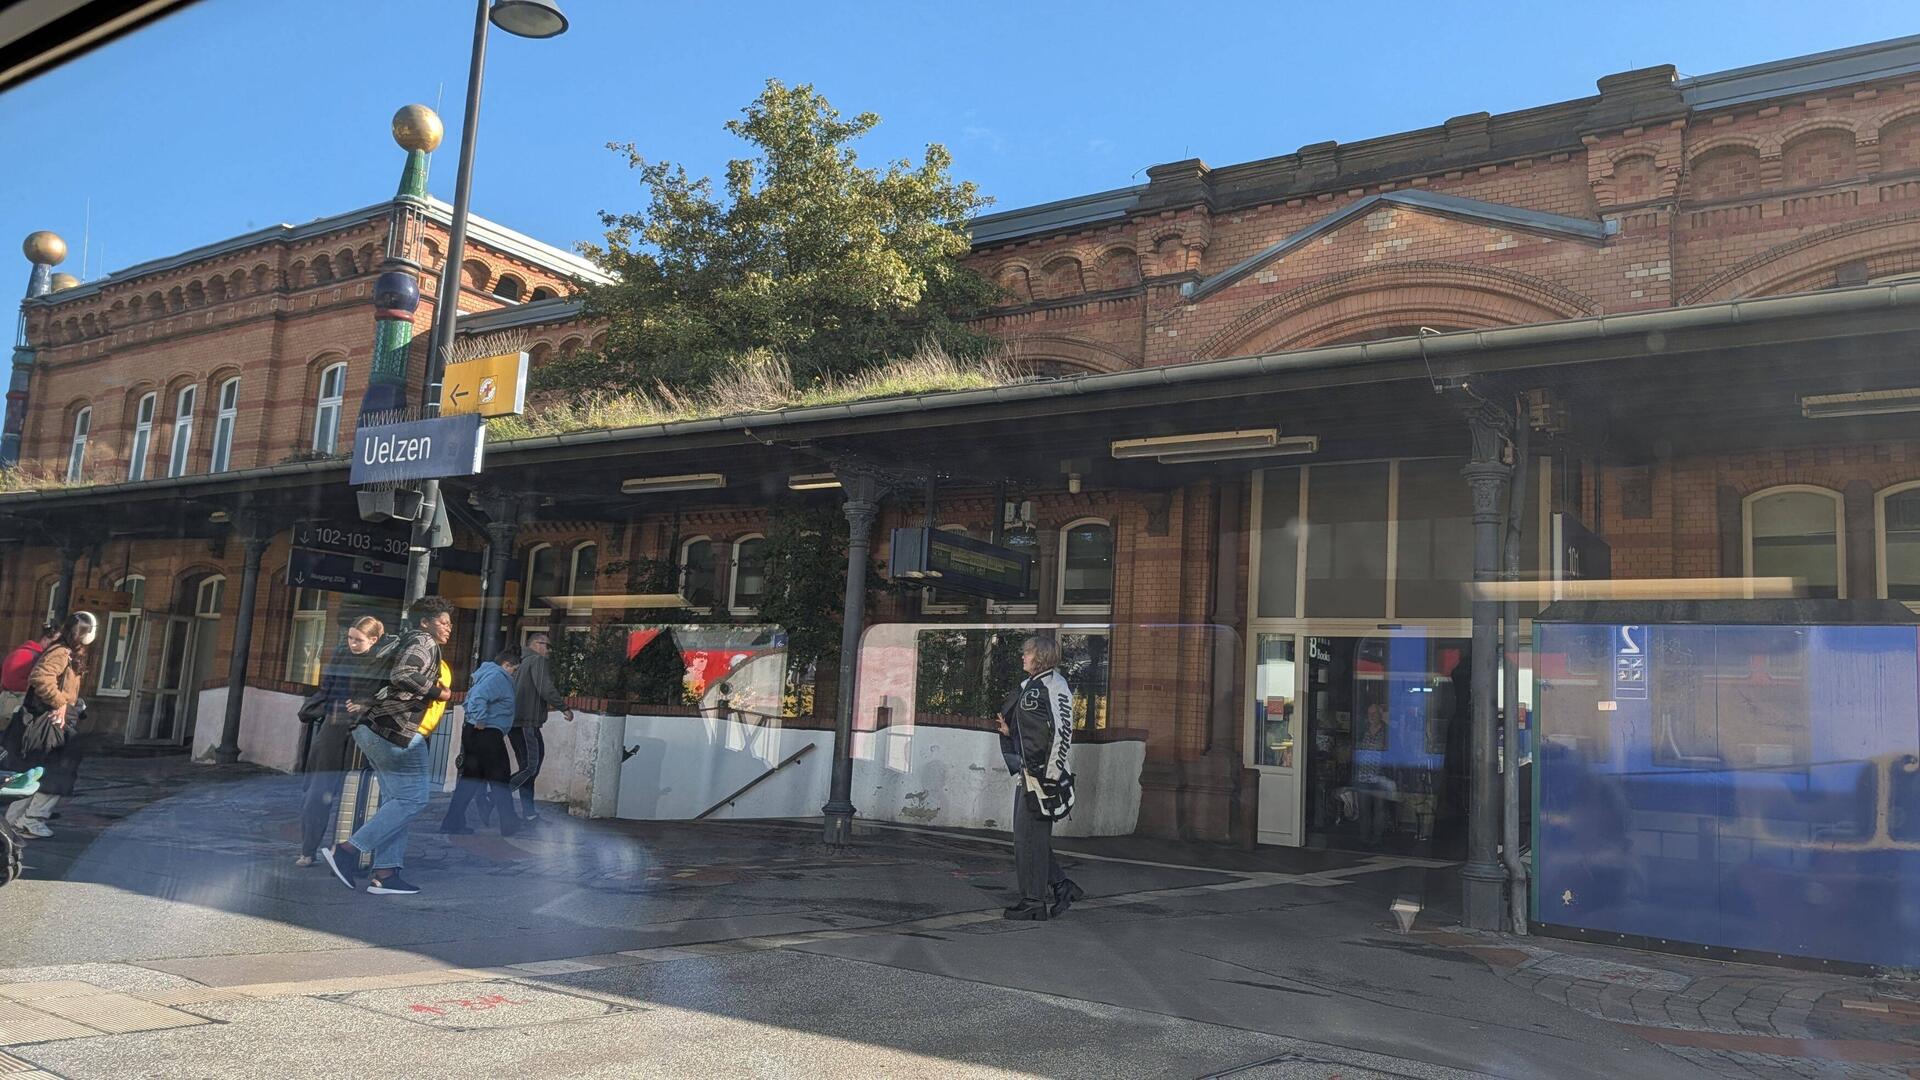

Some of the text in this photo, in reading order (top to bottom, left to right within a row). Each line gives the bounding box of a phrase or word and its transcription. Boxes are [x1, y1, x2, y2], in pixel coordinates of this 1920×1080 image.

[364, 435, 431, 465] Uelzen
[315, 528, 371, 550] 102-103
[1056, 693, 1072, 771] ninetytwo
